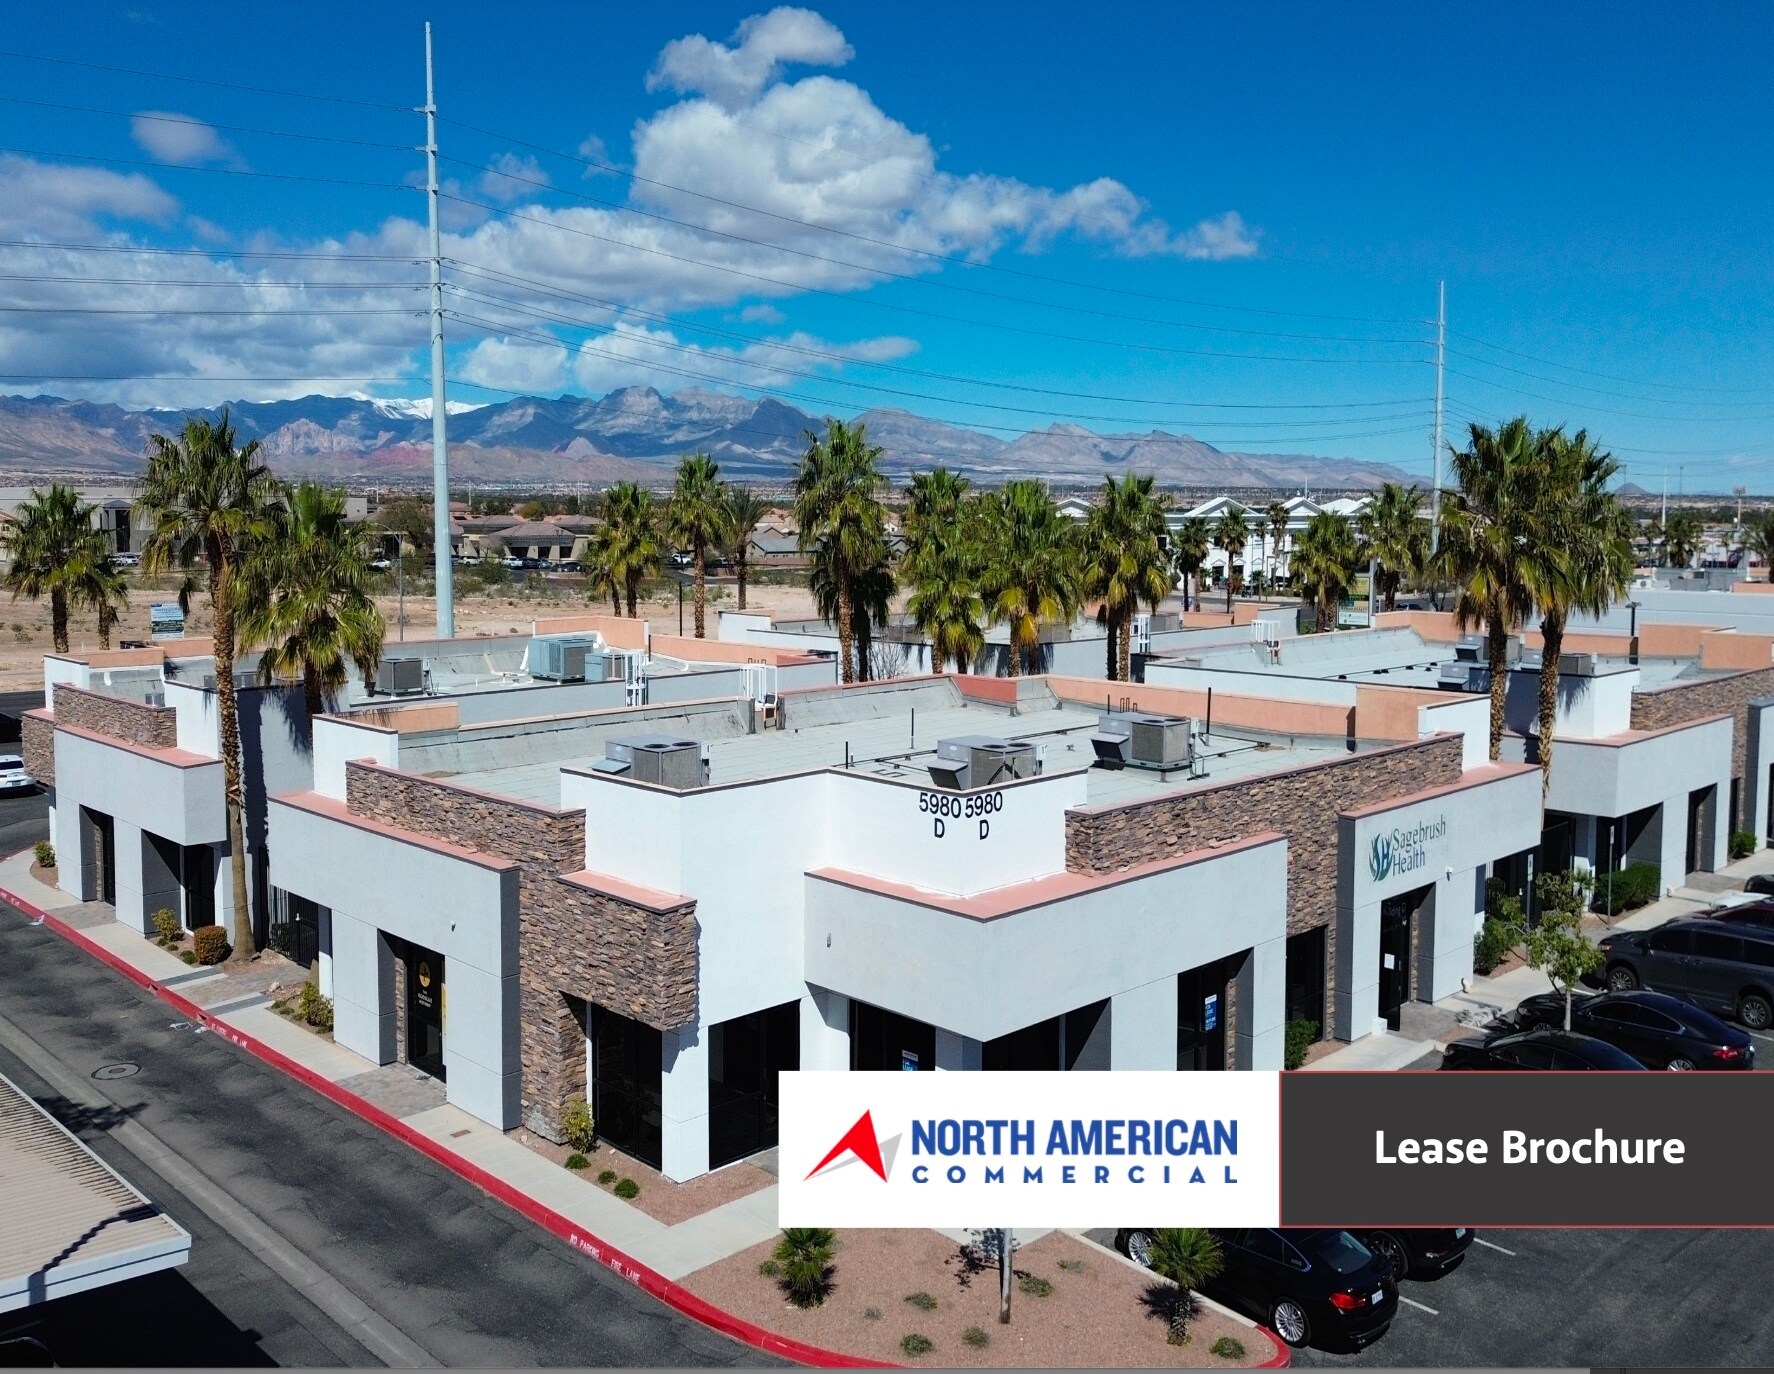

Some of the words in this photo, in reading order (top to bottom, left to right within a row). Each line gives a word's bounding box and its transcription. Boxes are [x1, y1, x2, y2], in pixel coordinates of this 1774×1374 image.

[919, 791, 962, 818] 5980
[965, 791, 1003, 818] 5980
[934, 818, 945, 838] D
[979, 819, 990, 840] D
[1393, 814, 1446, 853] Sagebrush
[1392, 845, 1425, 877] Health
[610, 1258, 622, 1273] FIRE
[626, 1267, 640, 1286] LANE
